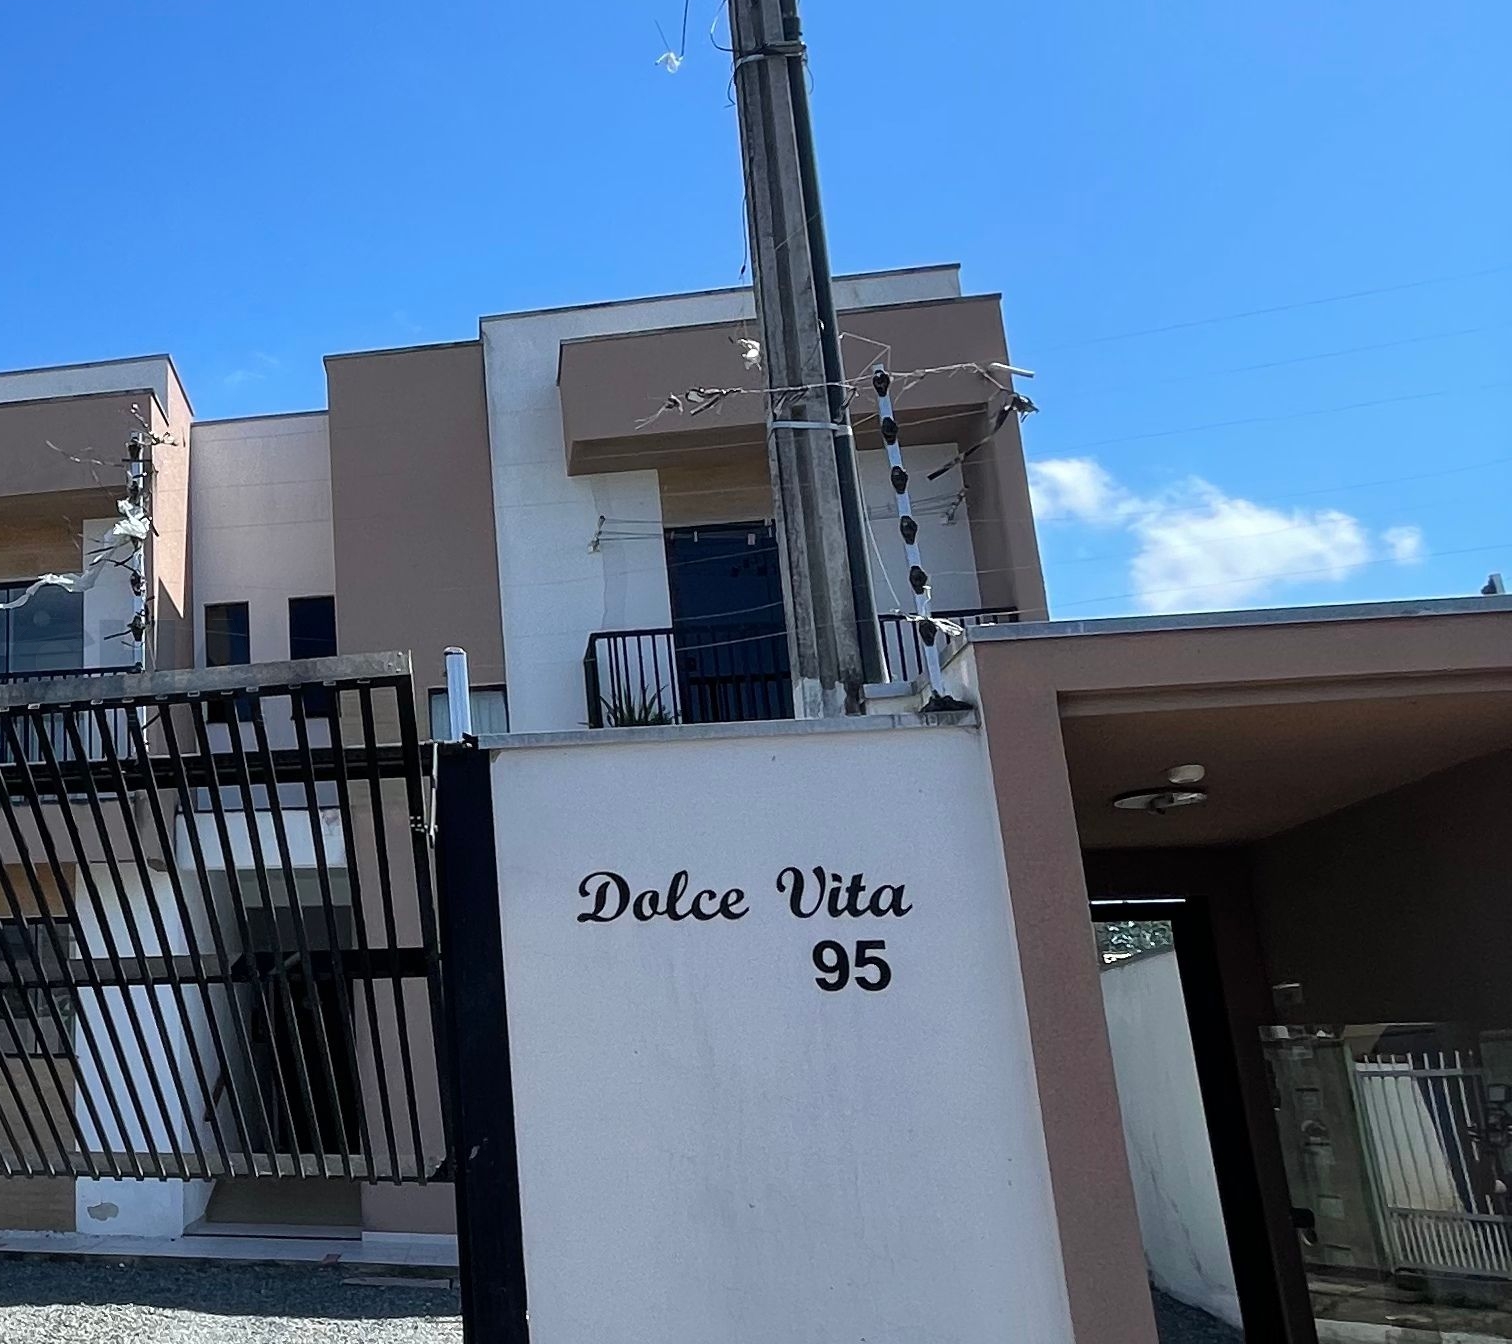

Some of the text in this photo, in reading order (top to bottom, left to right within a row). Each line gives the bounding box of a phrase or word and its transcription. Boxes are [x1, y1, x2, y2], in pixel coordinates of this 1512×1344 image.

[577, 866, 913, 923] Dolce Vita
[812, 940, 891, 992] 95
